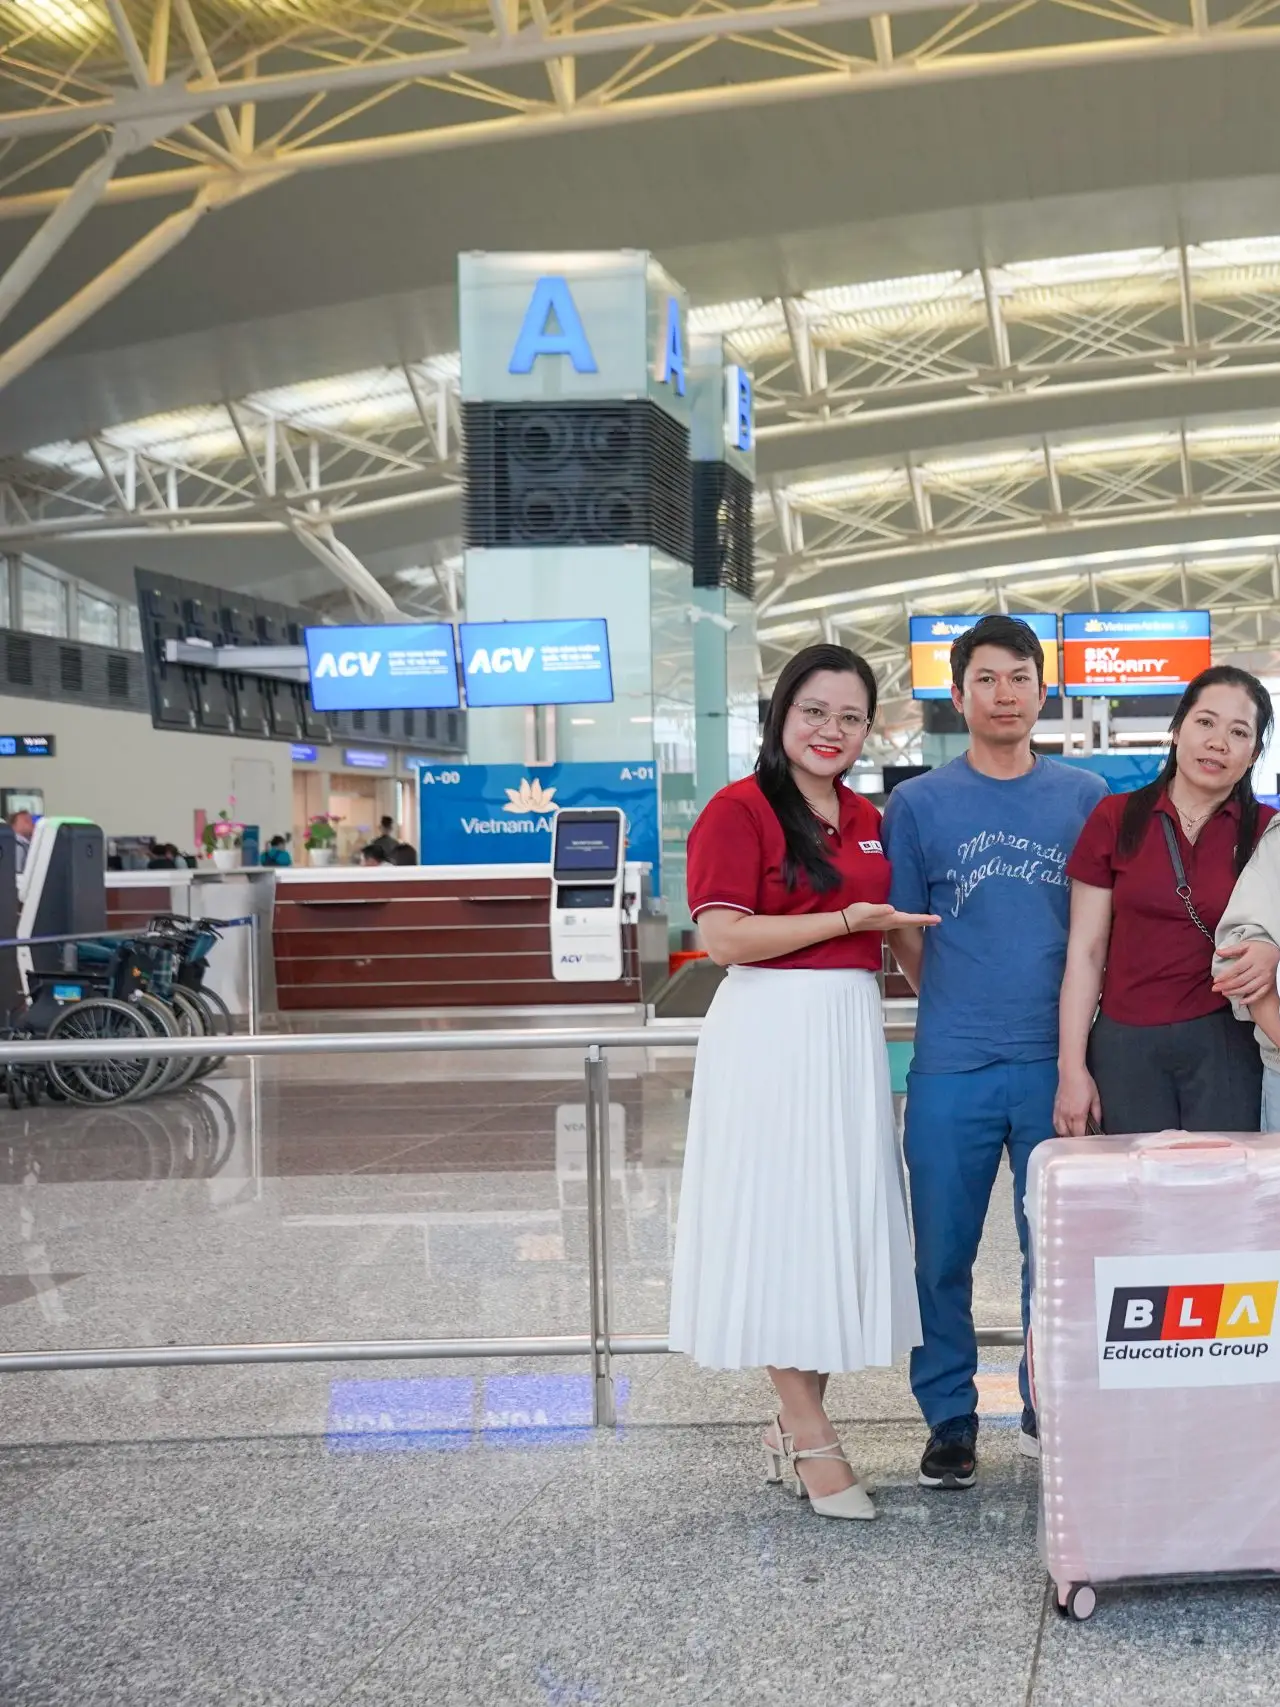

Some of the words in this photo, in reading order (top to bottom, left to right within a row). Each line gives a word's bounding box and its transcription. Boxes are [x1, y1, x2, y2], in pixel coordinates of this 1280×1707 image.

[508, 276, 599, 374] A
[658, 297, 686, 397] A
[314, 651, 381, 678] ACV
[468, 646, 536, 674] ACV
[1084, 659, 1166, 673] PRIORITY
[620, 767, 655, 781] A-01
[461, 817, 534, 835] Vietnam
[560, 955, 582, 964] ACV
[1103, 1342, 1204, 1360] Education
[1209, 1341, 1269, 1358] Group
